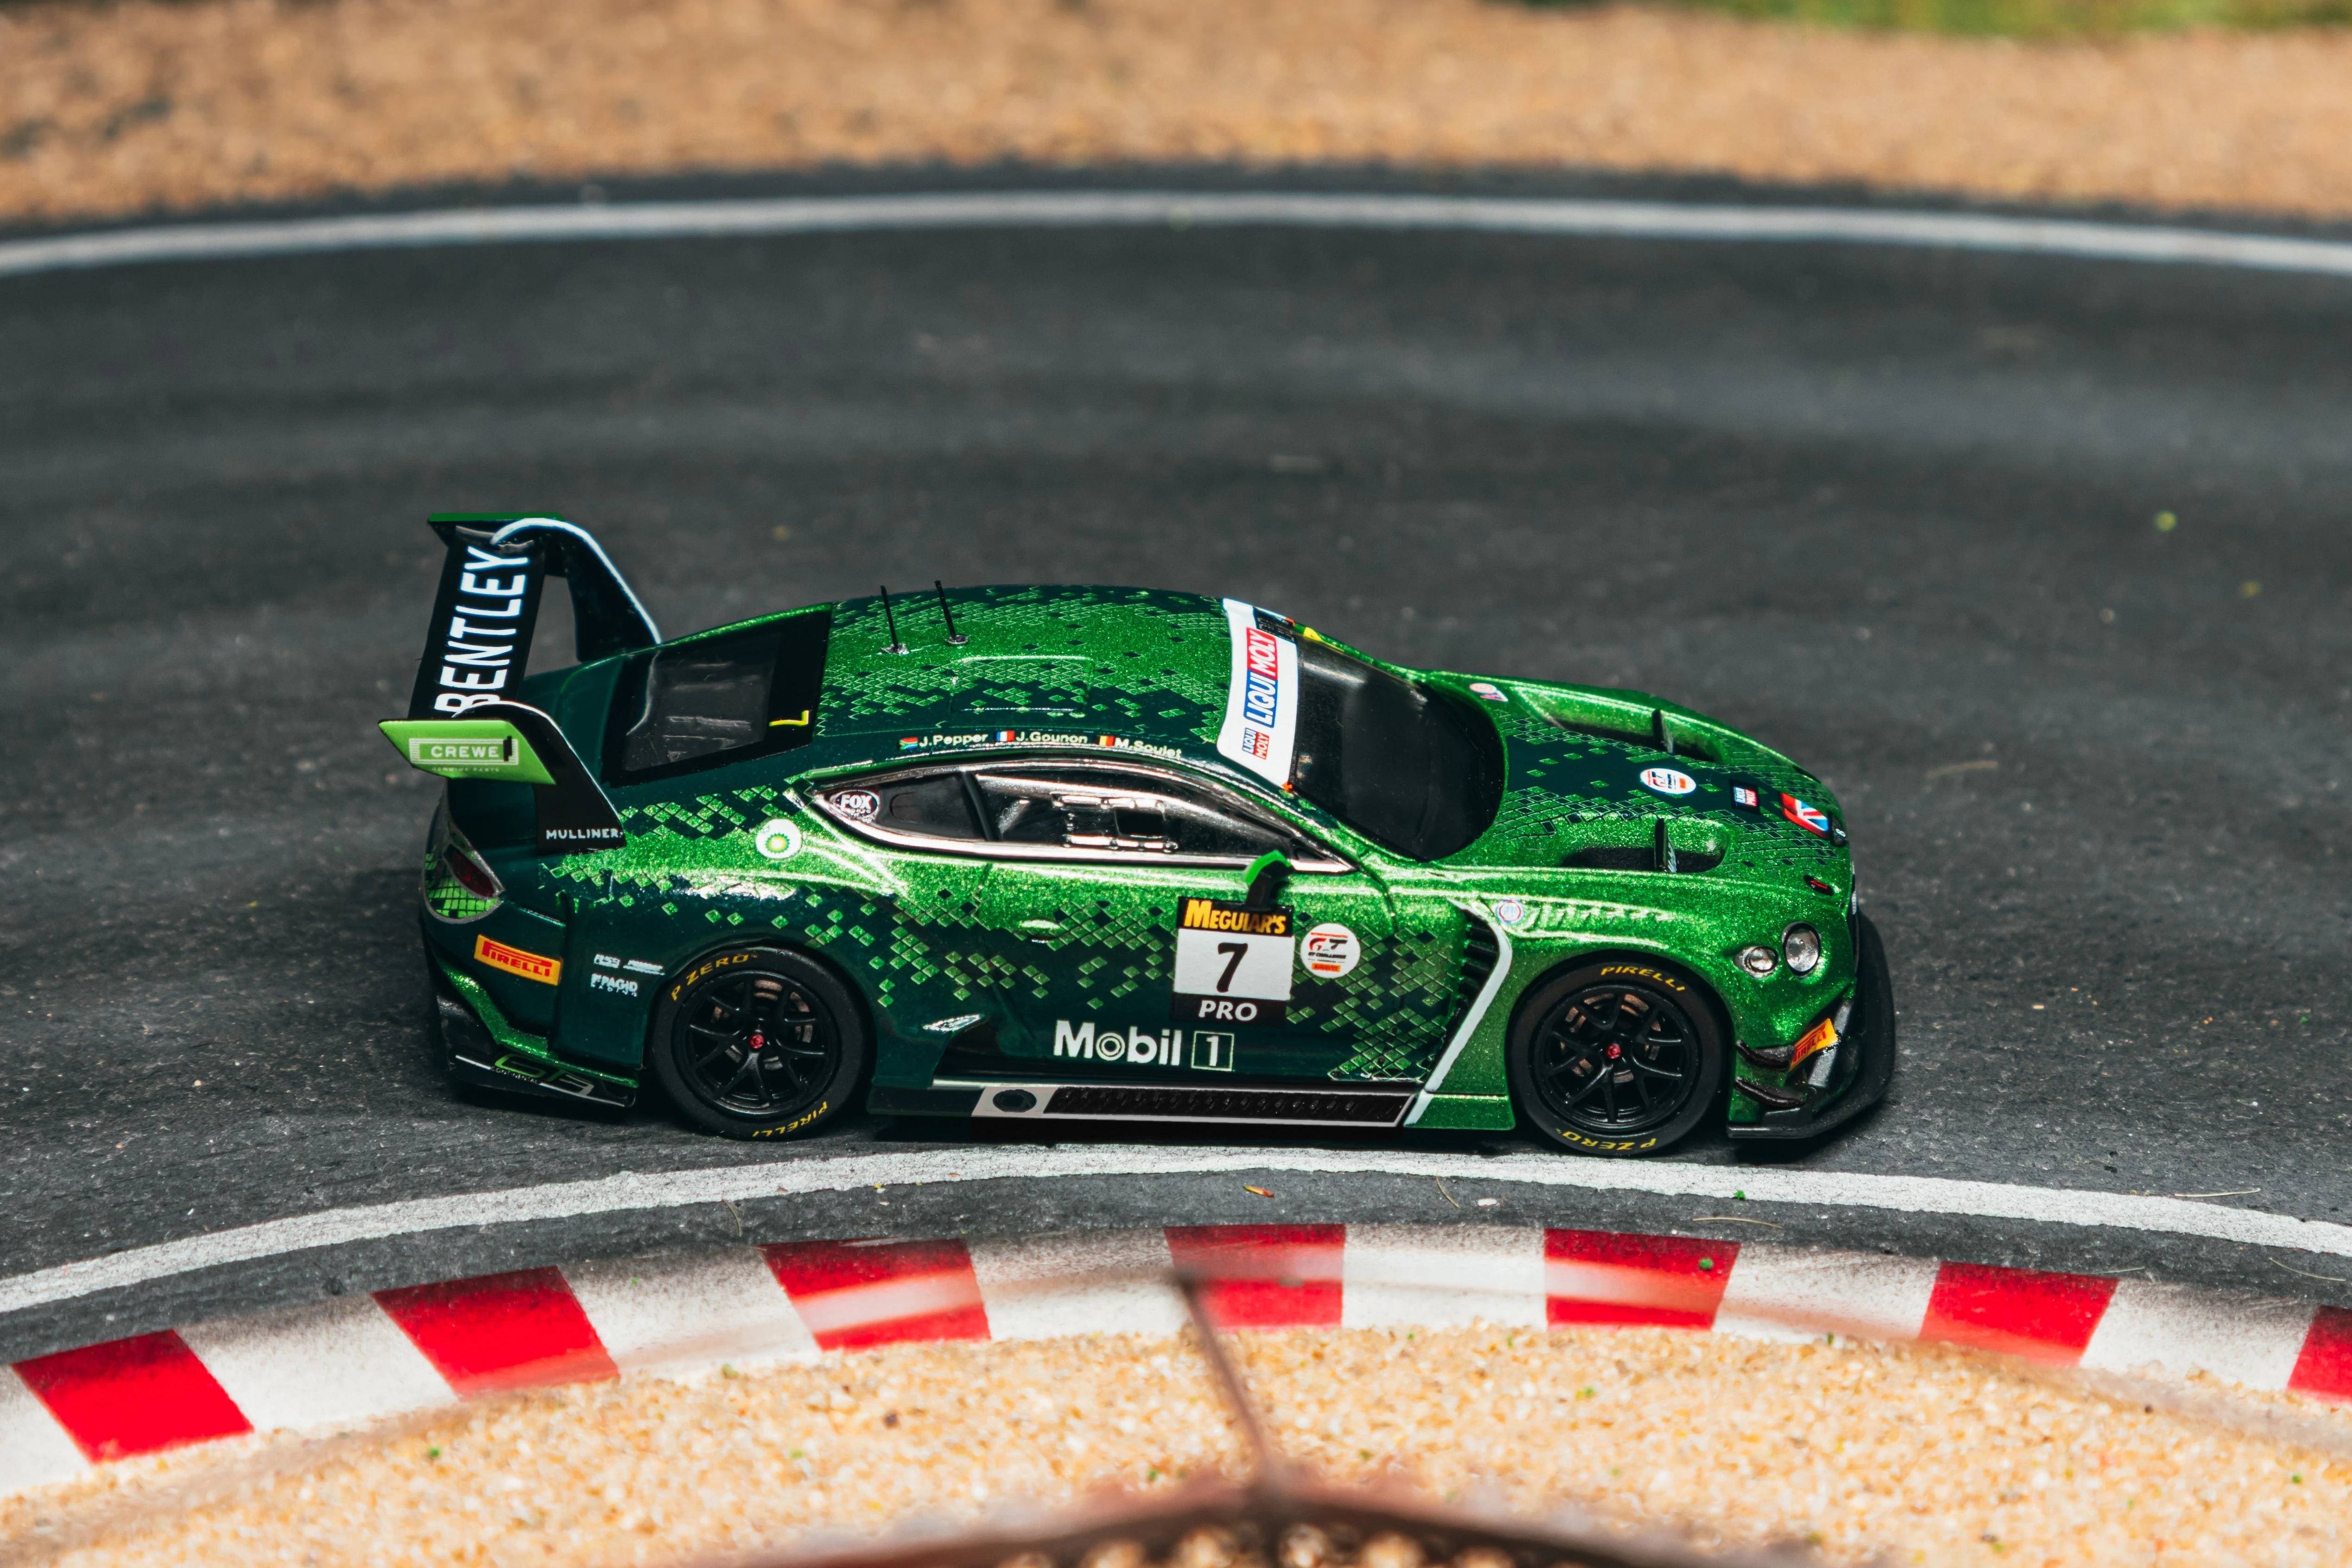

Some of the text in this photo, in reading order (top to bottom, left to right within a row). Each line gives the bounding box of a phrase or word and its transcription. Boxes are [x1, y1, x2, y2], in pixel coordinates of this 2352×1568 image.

[434, 545, 530, 714] BENTLEY
[1246, 630, 1275, 726] LIQUI MOLY
[919, 734, 988, 747] J.Pepper
[1016, 731, 1088, 743] J.Gounon
[1114, 737, 1182, 759] M.Soulet
[1243, 729, 1256, 754] LIQUI
[1256, 733, 1268, 759] MOLY
[431, 746, 499, 758] CREWE
[841, 794, 872, 812] FOX
[546, 828, 618, 840] MULLINER
[482, 940, 553, 977] PIRELLI
[686, 954, 749, 986] ZERO
[1217, 942, 1249, 993] 7
[1600, 966, 1686, 992] PIRELLI
[1198, 1000, 1257, 1021] PRO
[1053, 1020, 1182, 1066] Mobil
[752, 1101, 829, 1137] PIRELLI
